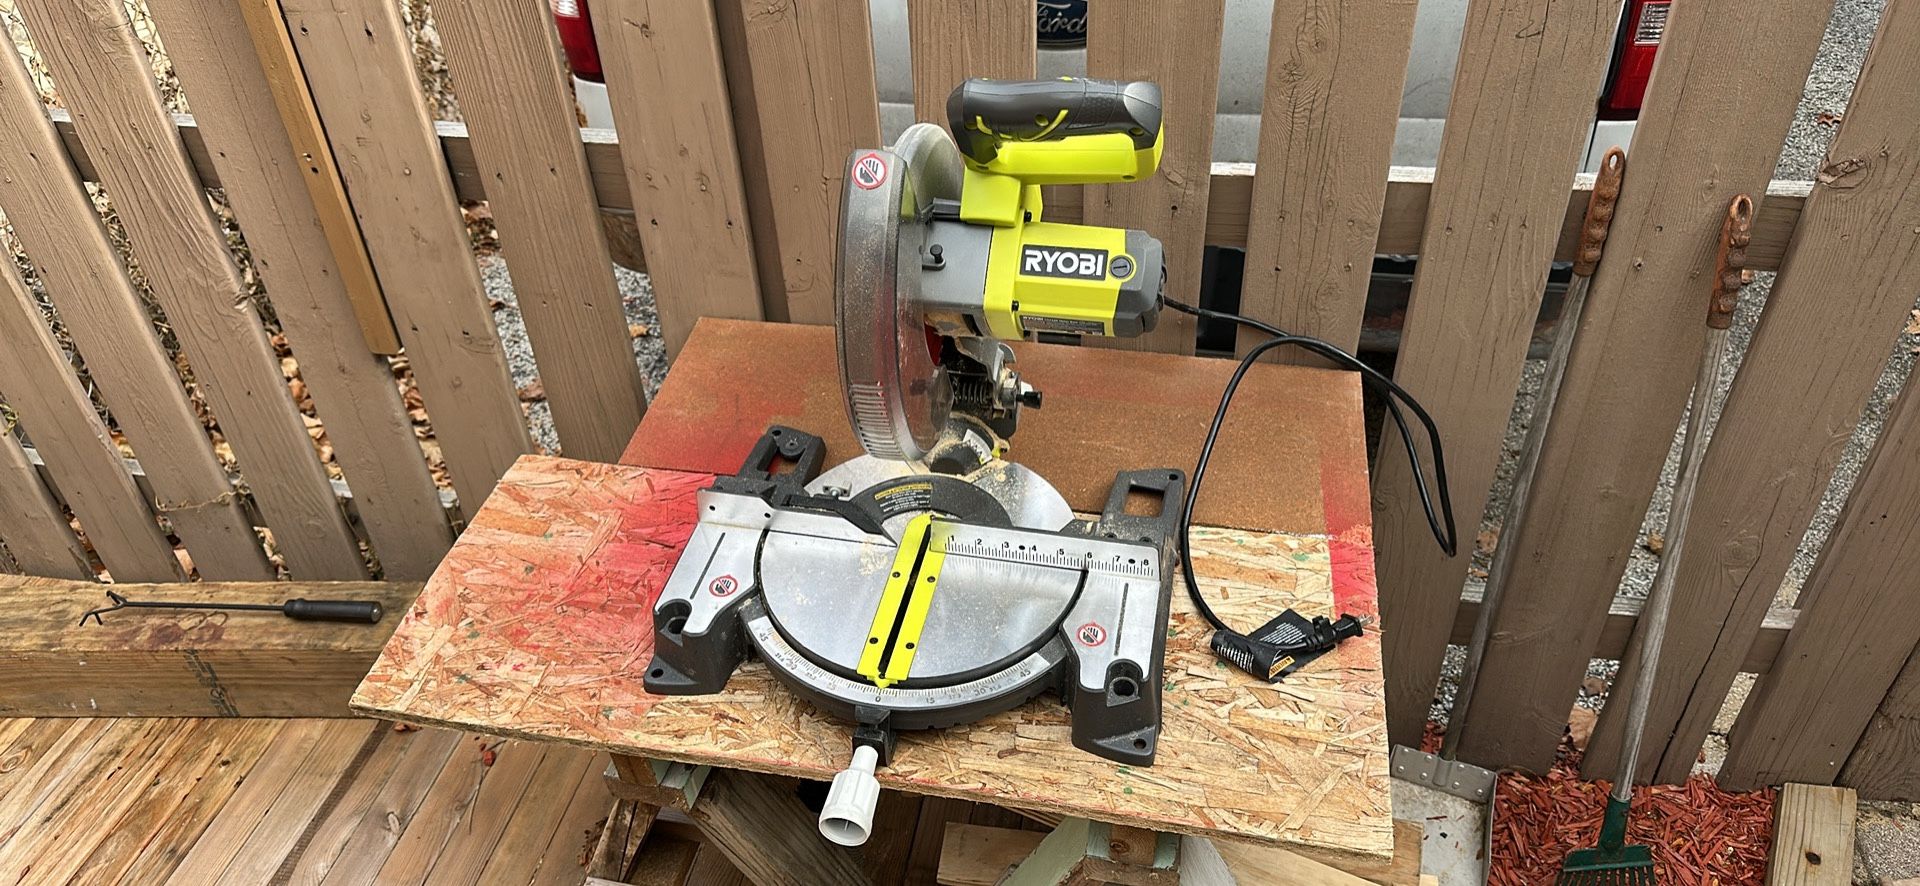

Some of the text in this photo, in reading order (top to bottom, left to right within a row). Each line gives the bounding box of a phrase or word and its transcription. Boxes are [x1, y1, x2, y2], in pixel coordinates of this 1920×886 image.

[1025, 249, 1104, 276] RYOBI
[1004, 541, 1010, 549] 3
[875, 695, 882, 703] 0
[1020, 668, 1031, 678] 45
